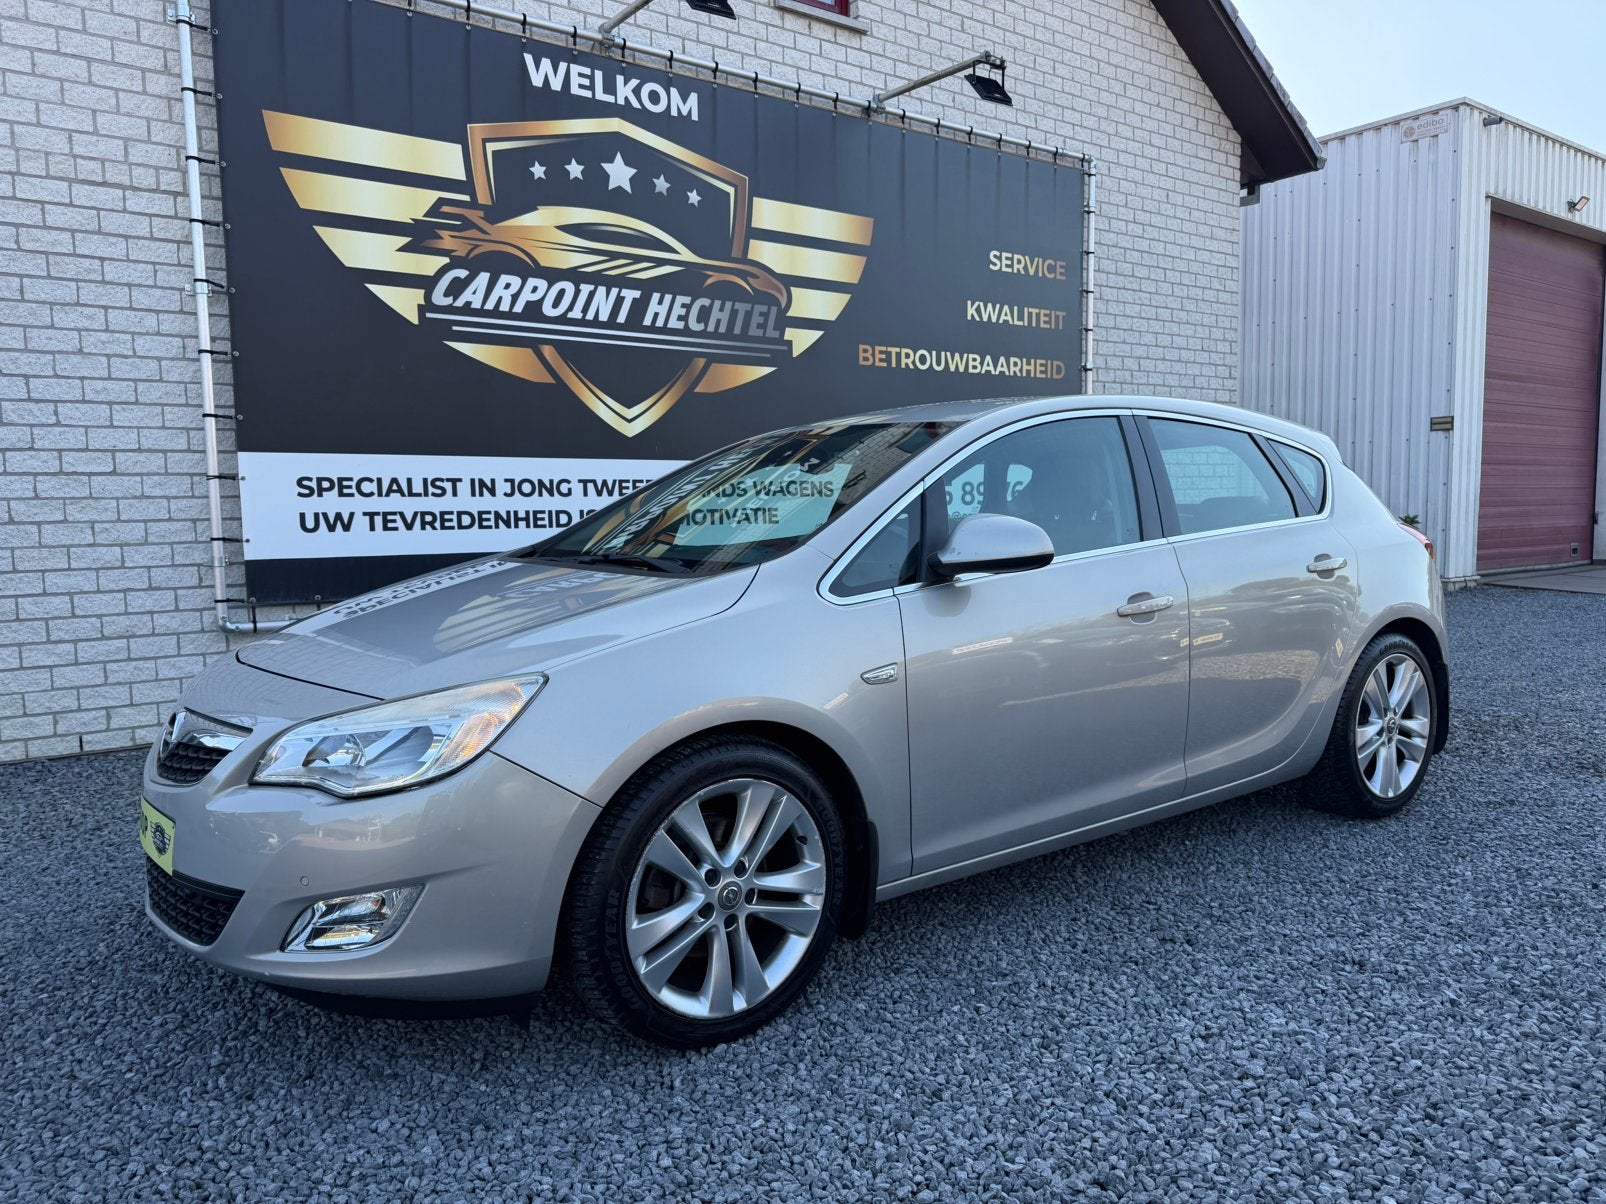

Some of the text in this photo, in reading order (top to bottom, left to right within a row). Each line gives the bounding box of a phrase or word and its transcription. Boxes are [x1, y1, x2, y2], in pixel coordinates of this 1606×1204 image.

[523, 52, 699, 122] WELKOM
[989, 250, 1067, 281] SERVICE
[431, 268, 782, 338] CARPOINT HECHTEL
[966, 300, 1066, 330] KWALITEIT
[858, 344, 1066, 380] BETROUWBAARHEID
[296, 476, 462, 498] SPECIALIST
[470, 477, 497, 498] IN
[503, 477, 573, 498] JONG
[752, 480, 834, 498] WAGENS
[298, 511, 355, 534] UW
[363, 509, 573, 532] TEVREDENHEID
